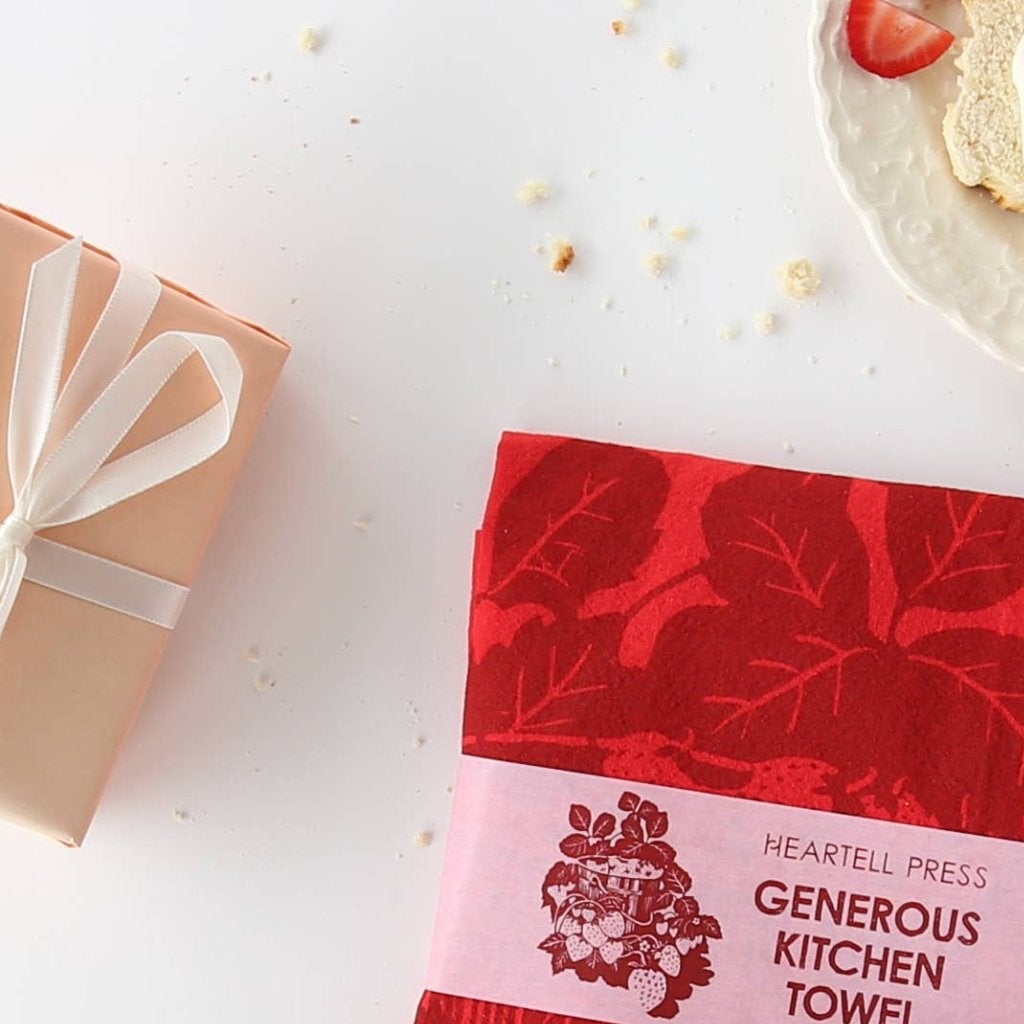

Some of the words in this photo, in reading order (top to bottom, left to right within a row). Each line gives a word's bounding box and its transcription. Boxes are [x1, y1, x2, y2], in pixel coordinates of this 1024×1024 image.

[764, 832, 893, 876] HEARTELL
[907, 857, 989, 890] PRESS
[753, 878, 982, 947] GENEROUS
[773, 931, 946, 991] KITCHEN
